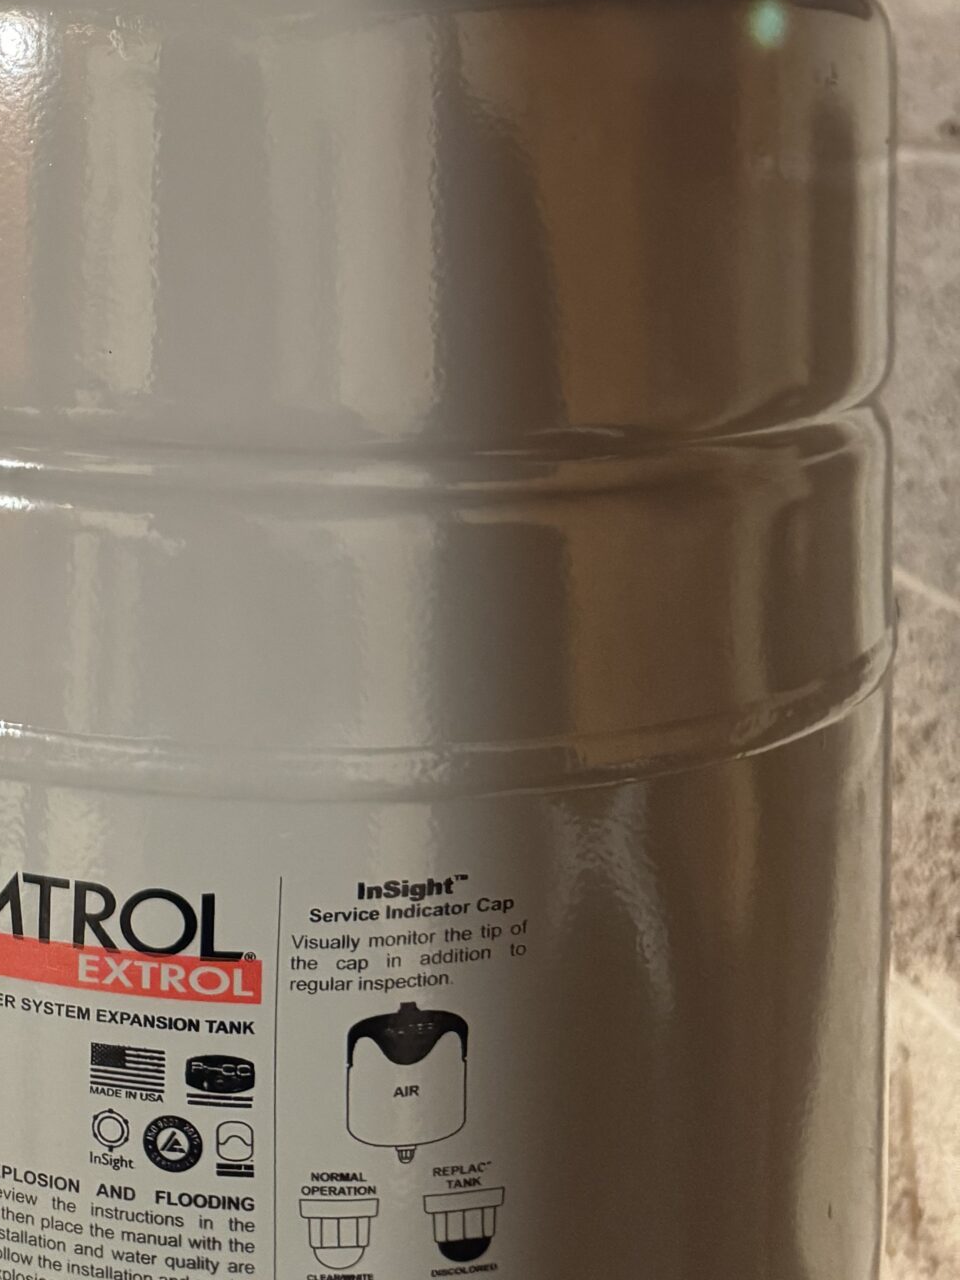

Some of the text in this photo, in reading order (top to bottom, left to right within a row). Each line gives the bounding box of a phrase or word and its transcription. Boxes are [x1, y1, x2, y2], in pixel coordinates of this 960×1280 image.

[309, 897, 514, 923] Service Indicator Cap
[292, 919, 528, 953] Visually monitor the tip of
[290, 944, 527, 973] the cap in addition to
[78, 954, 254, 997] EXTROL
[289, 972, 455, 995] regular inspection.
[21, 997, 91, 1021] SYSTEM
[96, 1009, 201, 1033] EXPANSION
[205, 1020, 256, 1035] TANK
[90, 1086, 164, 1103] MADE IN USA
[393, 1084, 420, 1098] AIR
[90, 1151, 134, 1171] InSight
[432, 1161, 493, 1177] REPLAC
[310, 1172, 367, 1182] NORMAL
[446, 1177, 482, 1189] TANK
[96, 1183, 136, 1201] AND
[155, 1189, 255, 1212] FLOODING
[301, 1185, 377, 1196] OPERATION
[52, 1196, 77, 1213] the
[90, 1202, 184, 1228] instructions
[199, 1214, 214, 1230] in
[228, 1217, 255, 1233] the
[1, 1206, 35, 1226] then
[41, 1216, 84, 1235] place
[89, 1223, 115, 1239] the
[121, 1229, 182, 1248] manual
[187, 1236, 223, 1251] with
[228, 1237, 255, 1254] the
[38, 1255, 63, 1272] the
[67, 1260, 153, 1280] installation
[74, 1243, 104, 1259] and
[111, 1248, 158, 1265] water
[165, 1255, 220, 1275] quality
[227, 1261, 255, 1275] are
